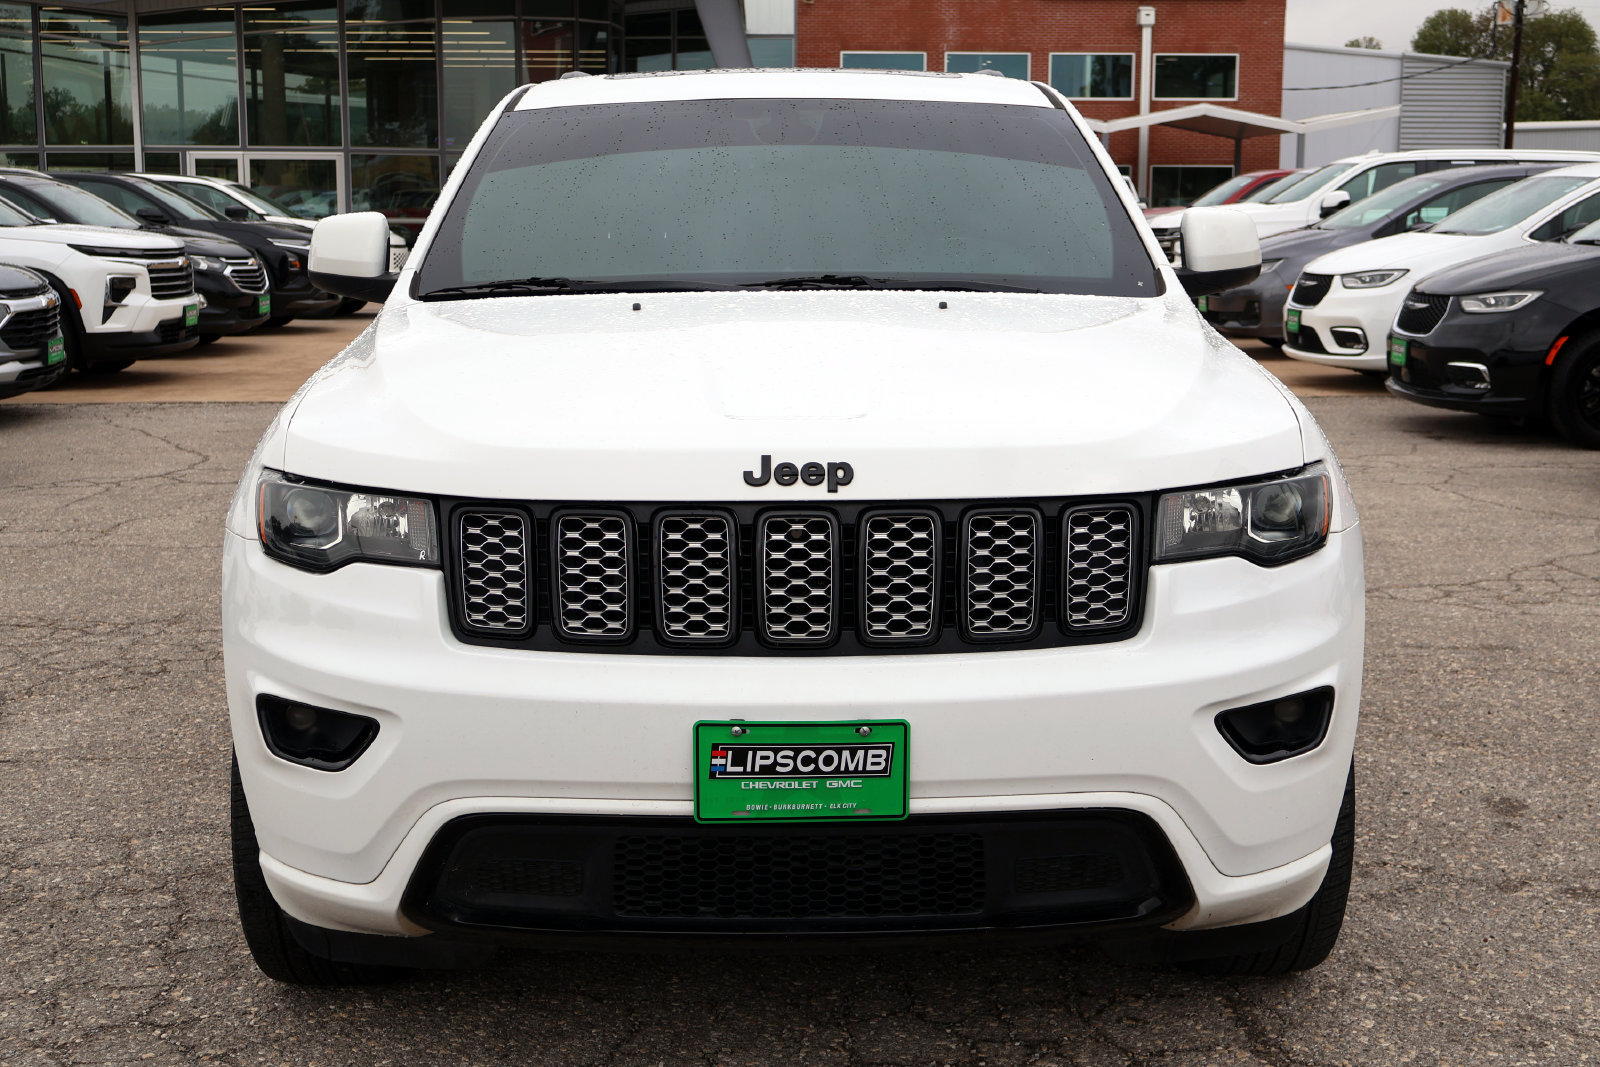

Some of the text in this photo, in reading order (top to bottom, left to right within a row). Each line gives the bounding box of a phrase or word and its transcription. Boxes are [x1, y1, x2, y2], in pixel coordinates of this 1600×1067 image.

[743, 454, 854, 493] Jeep
[726, 749, 888, 773] LIPSCOMB
[741, 779, 863, 789] CHEVROLET GMC
